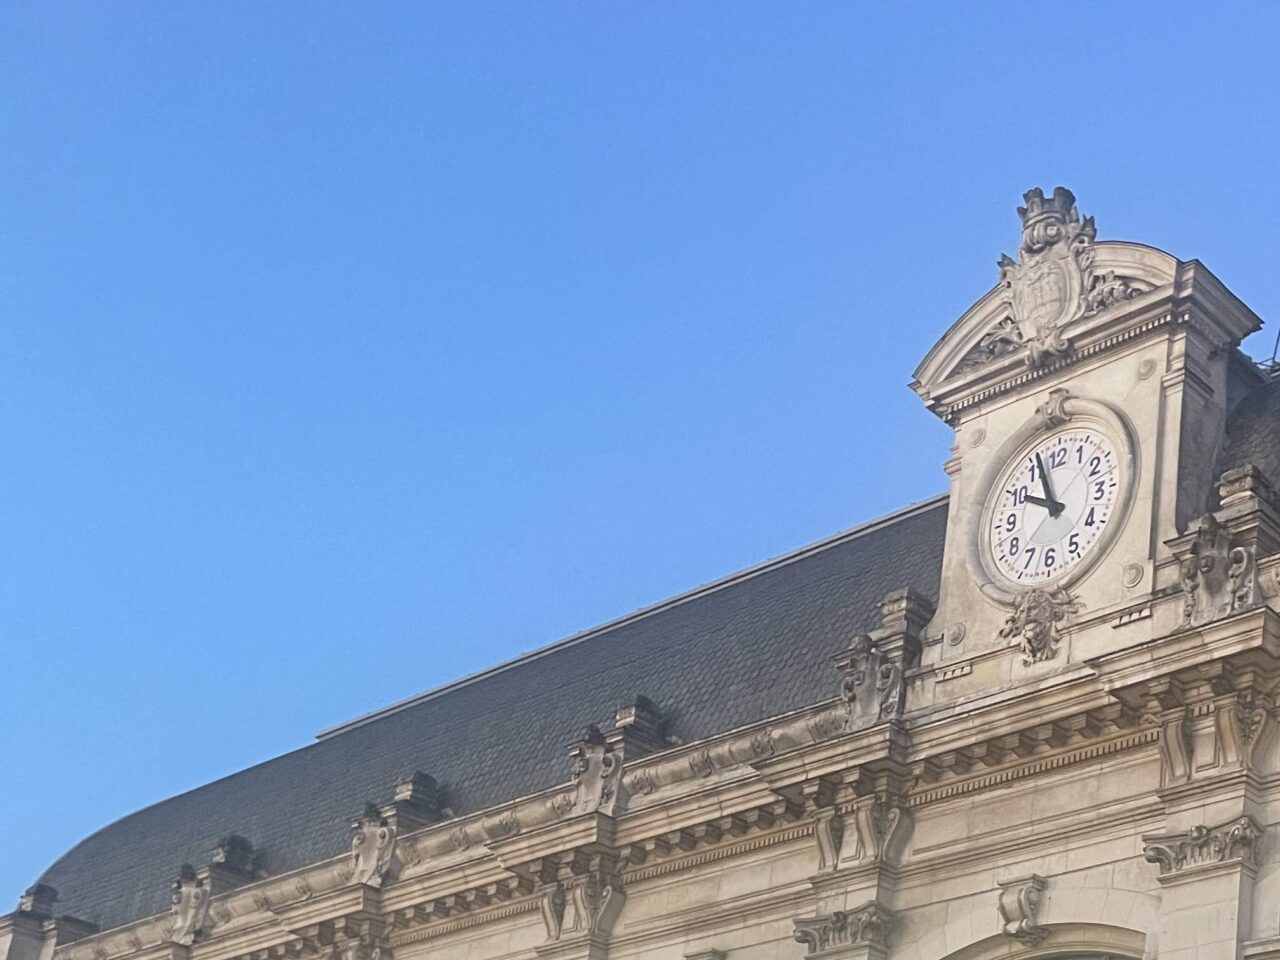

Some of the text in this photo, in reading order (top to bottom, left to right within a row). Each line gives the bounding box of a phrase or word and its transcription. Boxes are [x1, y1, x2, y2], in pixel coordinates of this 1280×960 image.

[1049, 447, 1068, 470] 12
[1075, 445, 1084, 464] 1
[1088, 456, 1101, 478] 2
[1010, 485, 1028, 507] 10
[1094, 481, 1105, 501] 3
[1006, 513, 1017, 532] 9
[1084, 507, 1095, 527] 4
[1009, 537, 1020, 556] 8
[1069, 533, 1080, 553] 5
[1024, 549, 1036, 569] 7
[1044, 548, 1056, 568] 6
